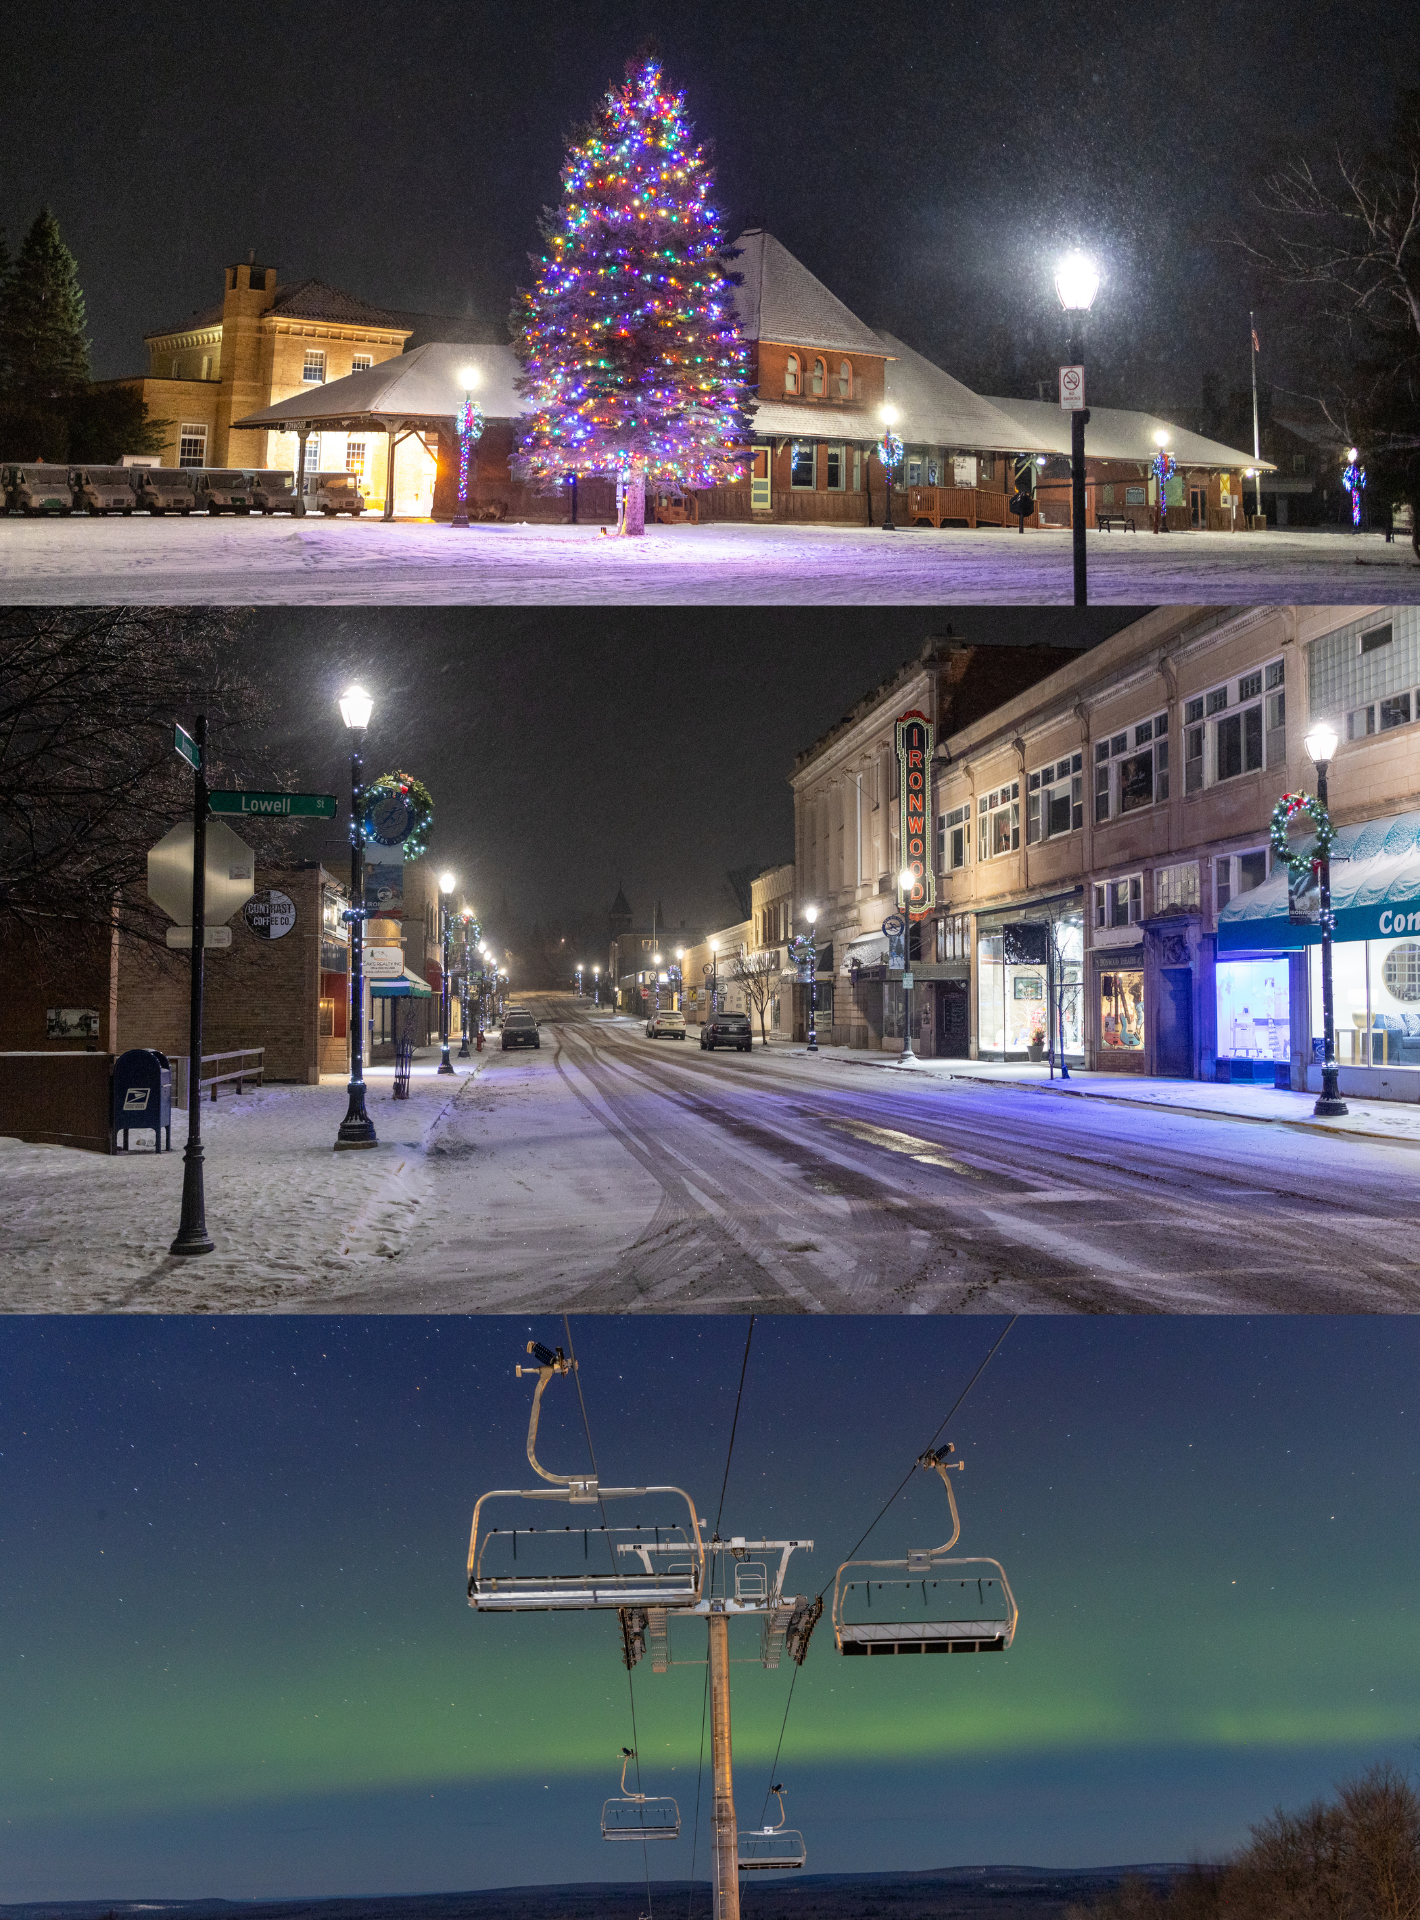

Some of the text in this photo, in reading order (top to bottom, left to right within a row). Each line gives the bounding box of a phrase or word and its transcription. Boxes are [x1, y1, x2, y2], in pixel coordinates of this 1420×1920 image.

[241, 796, 325, 813] Lowell St
[908, 728, 924, 900] IRONWOOD
[248, 904, 292, 914] CONTRAST
[253, 917, 291, 926] COFFEE CO.
